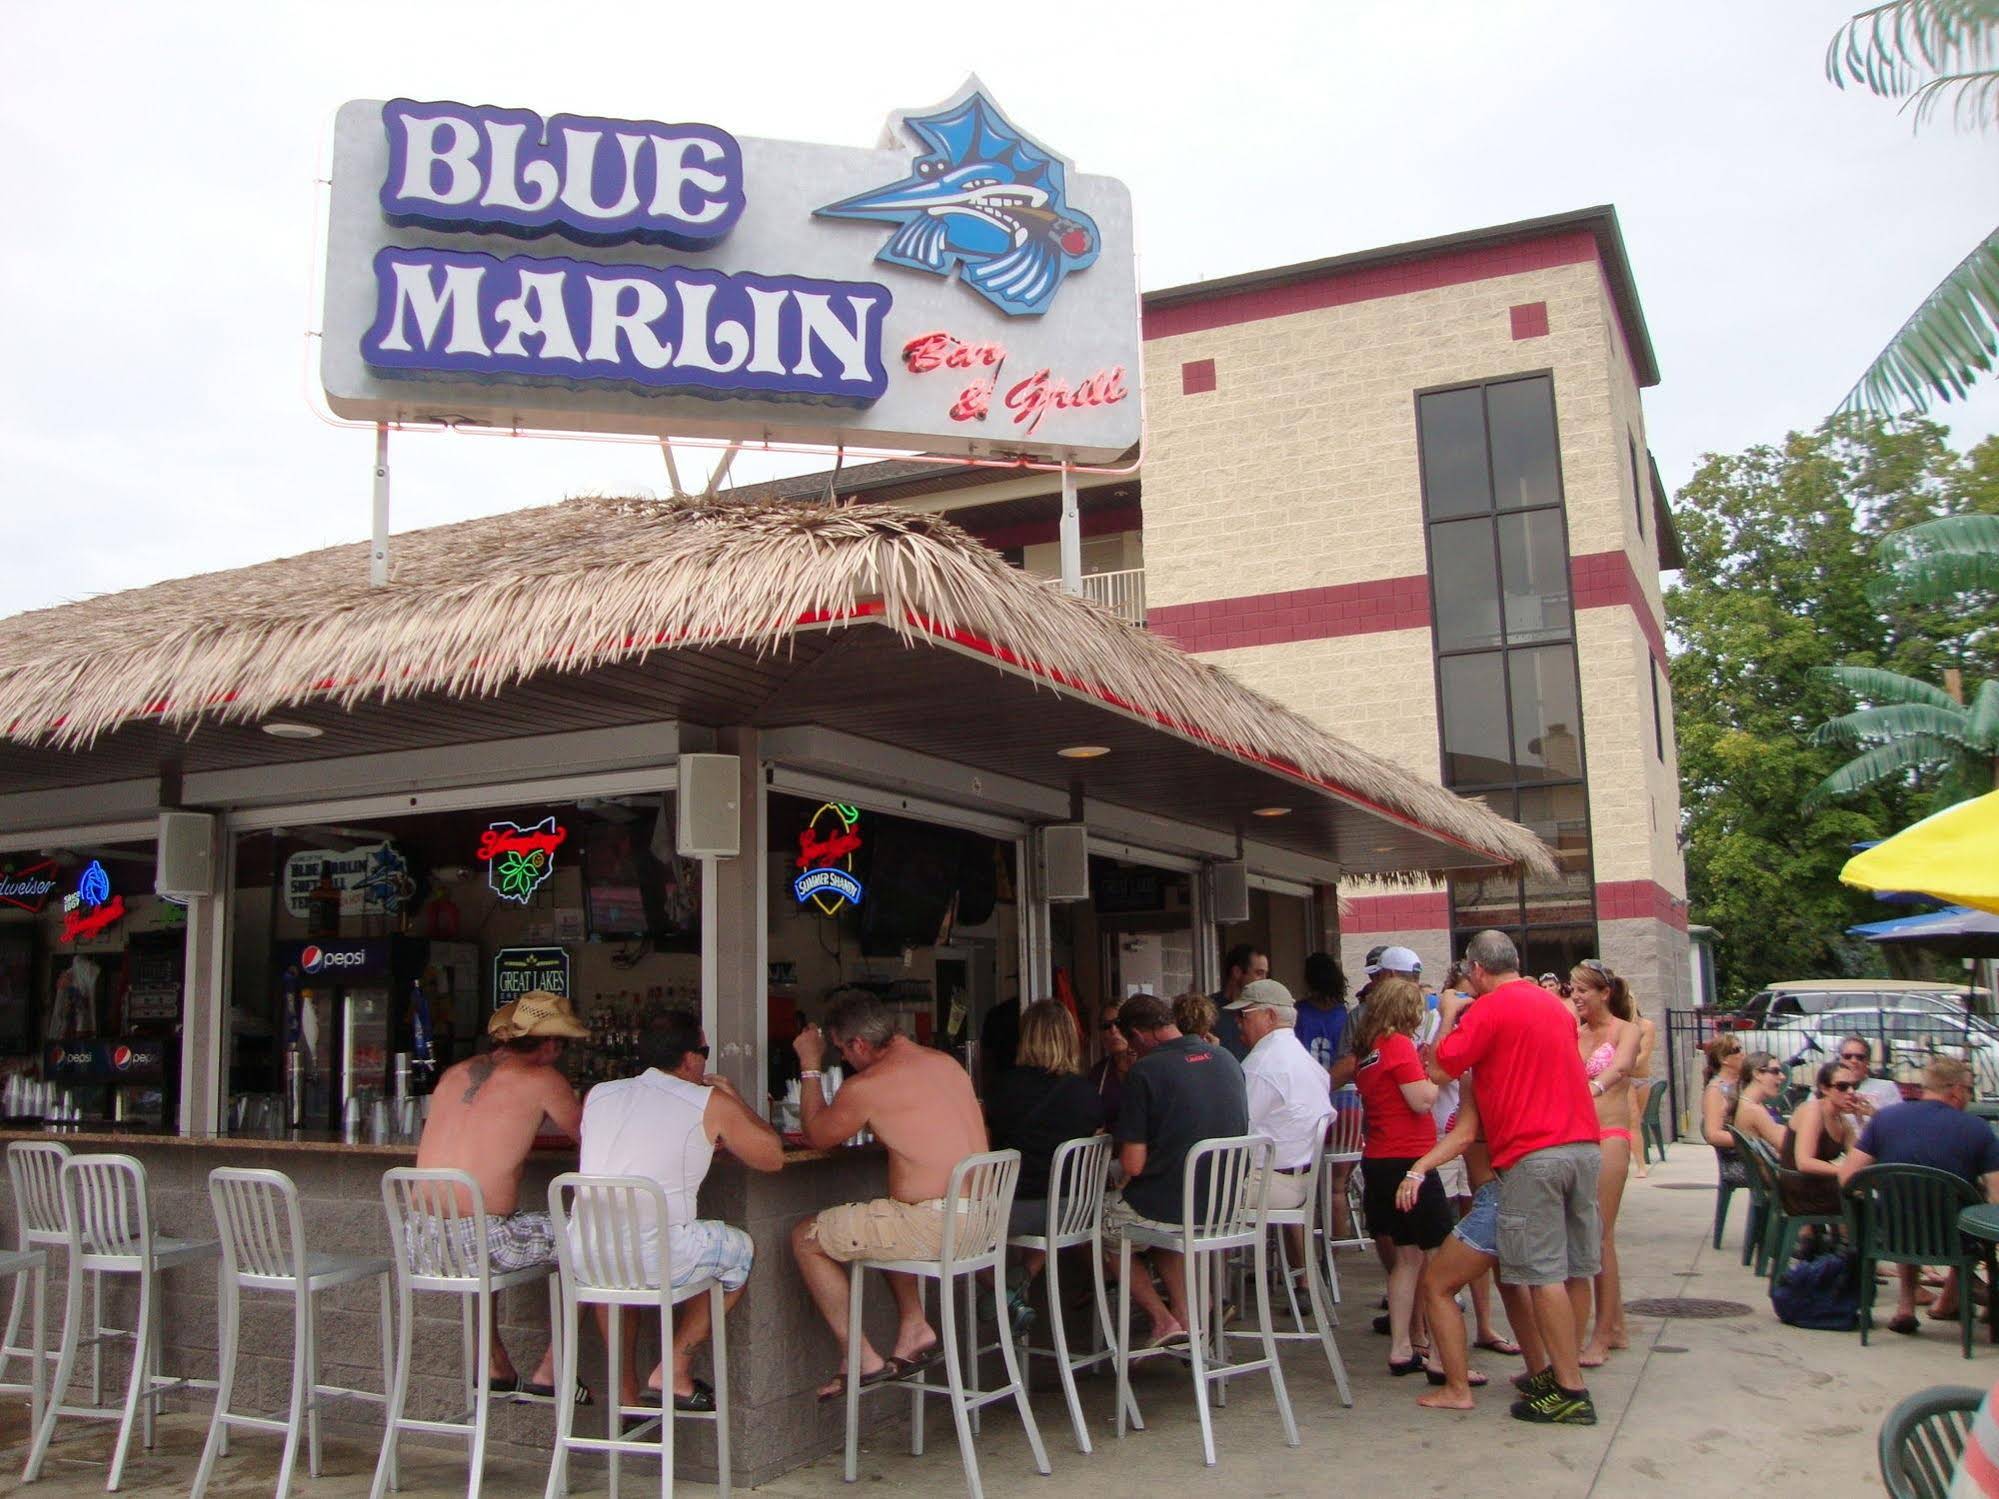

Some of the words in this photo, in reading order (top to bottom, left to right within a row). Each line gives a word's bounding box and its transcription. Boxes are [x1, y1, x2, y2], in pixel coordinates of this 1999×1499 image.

[396, 113, 730, 223] BLUE
[378, 261, 879, 383] MARLIN
[902, 333, 1006, 374] Bar
[949, 377, 990, 423] &
[1003, 366, 1128, 436] Grill
[0, 874, 57, 896] dweiser
[798, 872, 829, 896] SUMMER
[829, 872, 858, 897] SHANDY
[323, 948, 365, 969] pepsi
[499, 970, 532, 992] GREAT
[532, 970, 565, 992] LAKES
[67, 1051, 92, 1065] pepsi
[132, 1053, 153, 1065] pep
